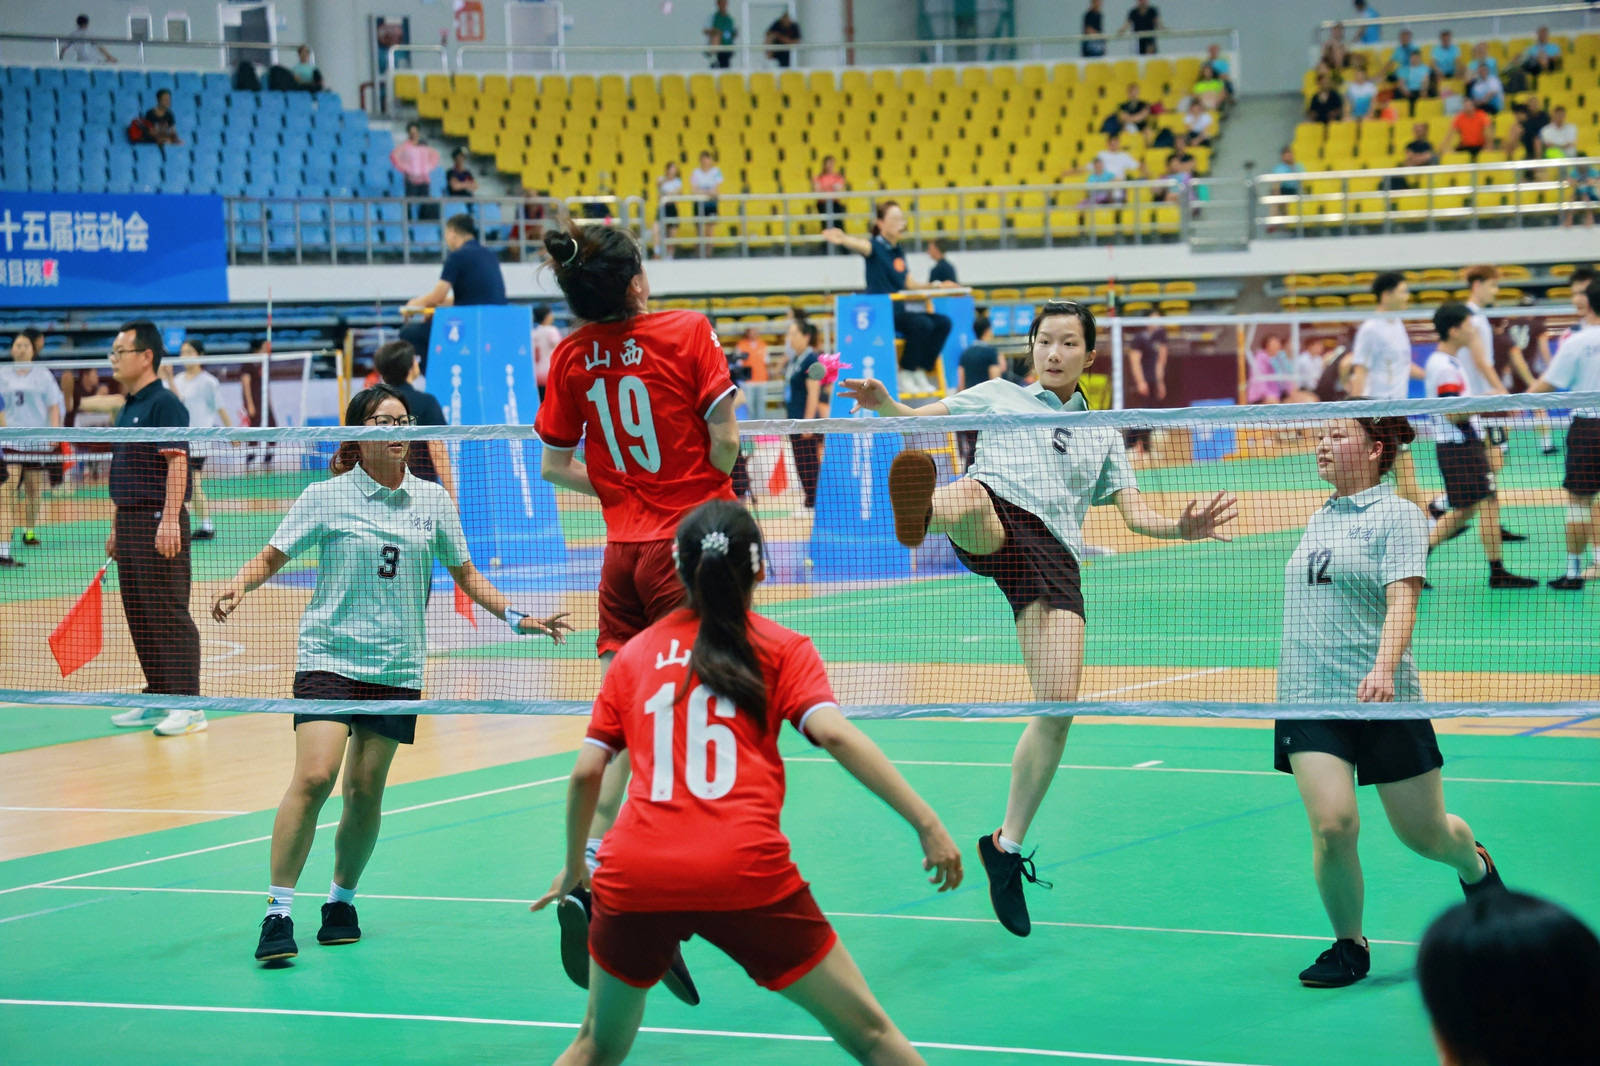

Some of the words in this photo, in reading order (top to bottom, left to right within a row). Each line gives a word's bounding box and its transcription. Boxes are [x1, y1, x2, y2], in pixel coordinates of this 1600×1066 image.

[0, 210, 149, 252] 十五届运动会
[585, 338, 644, 371] 山西
[586, 375, 661, 474] 19
[377, 543, 400, 579] 3
[1306, 547, 1334, 587] 12
[655, 639, 692, 670] 山
[645, 682, 738, 802] 16
